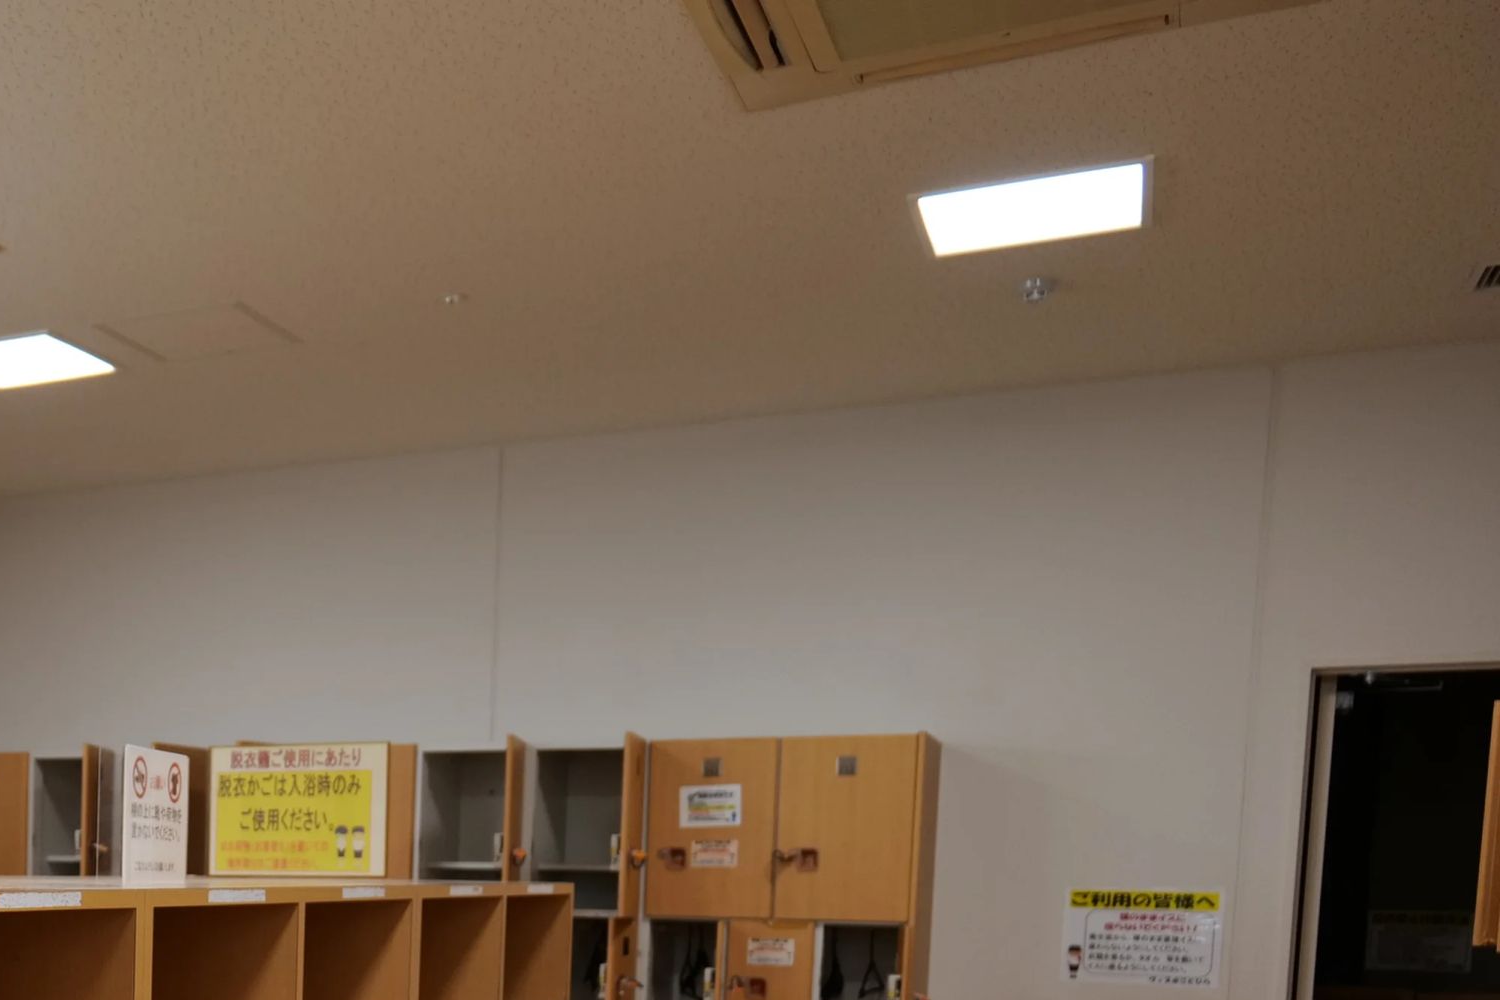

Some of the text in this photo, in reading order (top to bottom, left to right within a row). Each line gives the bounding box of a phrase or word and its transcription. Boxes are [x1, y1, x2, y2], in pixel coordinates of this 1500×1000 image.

[218, 772, 361, 797] 脱衣かごは入浴時のみ
[240, 808, 334, 831] ご使用ください。
[1071, 891, 1215, 909] ご利用の皆様へ
